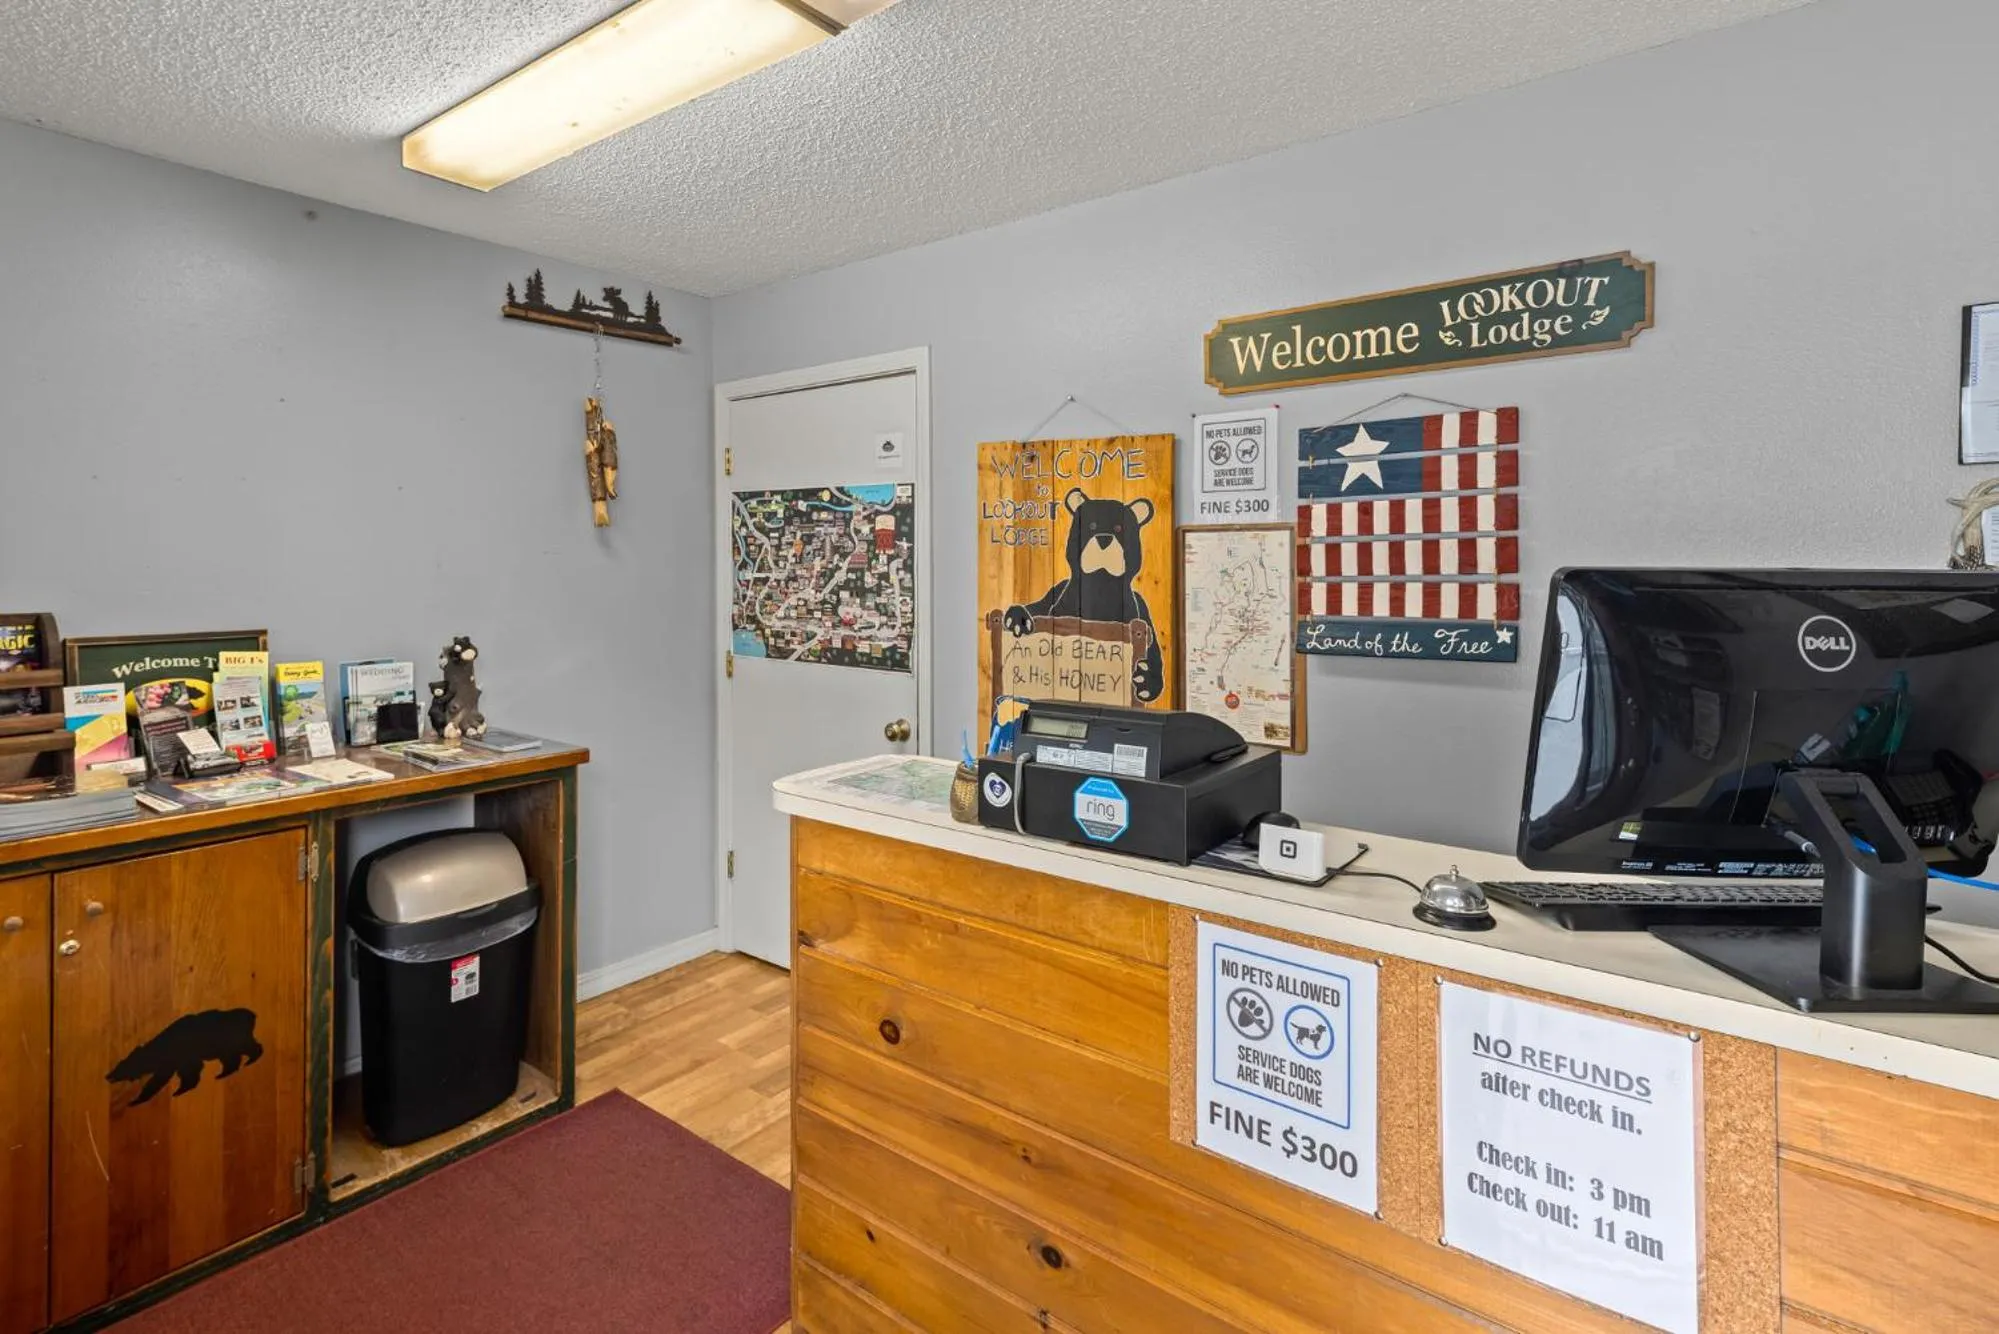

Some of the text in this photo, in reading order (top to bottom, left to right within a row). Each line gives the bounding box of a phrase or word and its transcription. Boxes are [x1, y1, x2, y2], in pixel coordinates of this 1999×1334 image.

[1439, 276, 1611, 327] LOOKOUT
[1470, 312, 1573, 348] Lodge
[1229, 322, 1420, 376] Welcome
[1206, 426, 1263, 439] NO PETS ALLOWED
[991, 449, 1147, 480] WELCOME
[1213, 467, 1254, 477] SERVICE DOGS
[1036, 485, 1049, 497] to
[1213, 477, 1254, 487] ARE WELCOME
[982, 500, 1062, 520] LOOKOUT
[1200, 498, 1269, 514] FINE $300
[991, 525, 1049, 546] LODGE
[1006, 639, 1123, 661] An Old BEAR
[1306, 624, 1494, 656] Land of the Free
[1804, 636, 1850, 651] DELL
[112, 656, 200, 679] Welcome
[225, 656, 246, 665] BIG
[1013, 665, 1121, 692] & His HONEY
[1087, 799, 1115, 821] ring
[1221, 958, 1341, 1008] NO PETS ALLOWED
[1237, 1044, 1322, 1087] SERVICE DOGS
[1473, 1032, 1652, 1098] NO REFUNDS
[1237, 1063, 1323, 1108] ARE WELCOME
[1480, 1071, 1643, 1135] after check in.
[1209, 1100, 1359, 1179] FINE $300
[1476, 1140, 1652, 1219] Check in: 3 pm
[1467, 1171, 1664, 1262] Check out: 11 am
